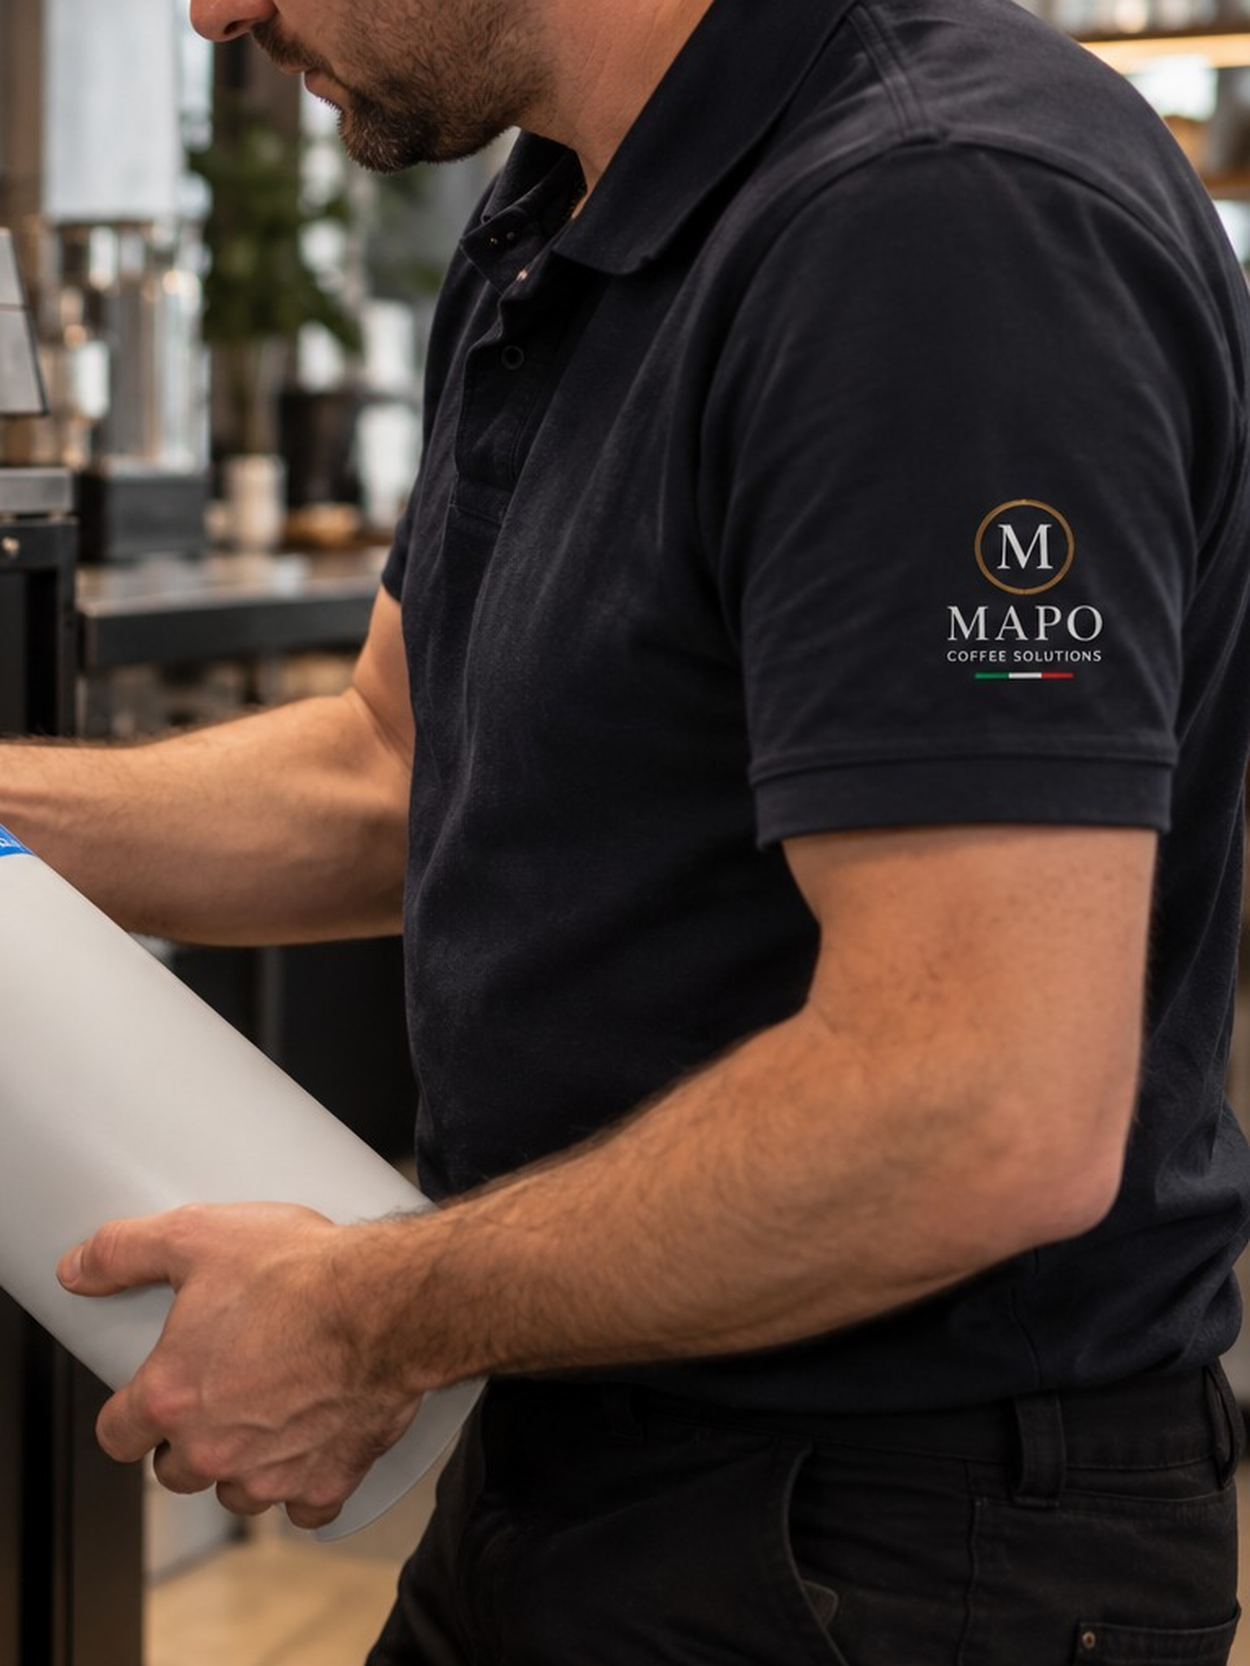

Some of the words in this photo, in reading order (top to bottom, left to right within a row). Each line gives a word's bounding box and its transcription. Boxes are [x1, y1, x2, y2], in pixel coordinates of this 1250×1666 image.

[997, 523, 1053, 569] M
[946, 604, 1103, 642] MAPO
[946, 650, 1007, 662] COFFEE
[1013, 650, 1102, 662] SOLUTIONS
